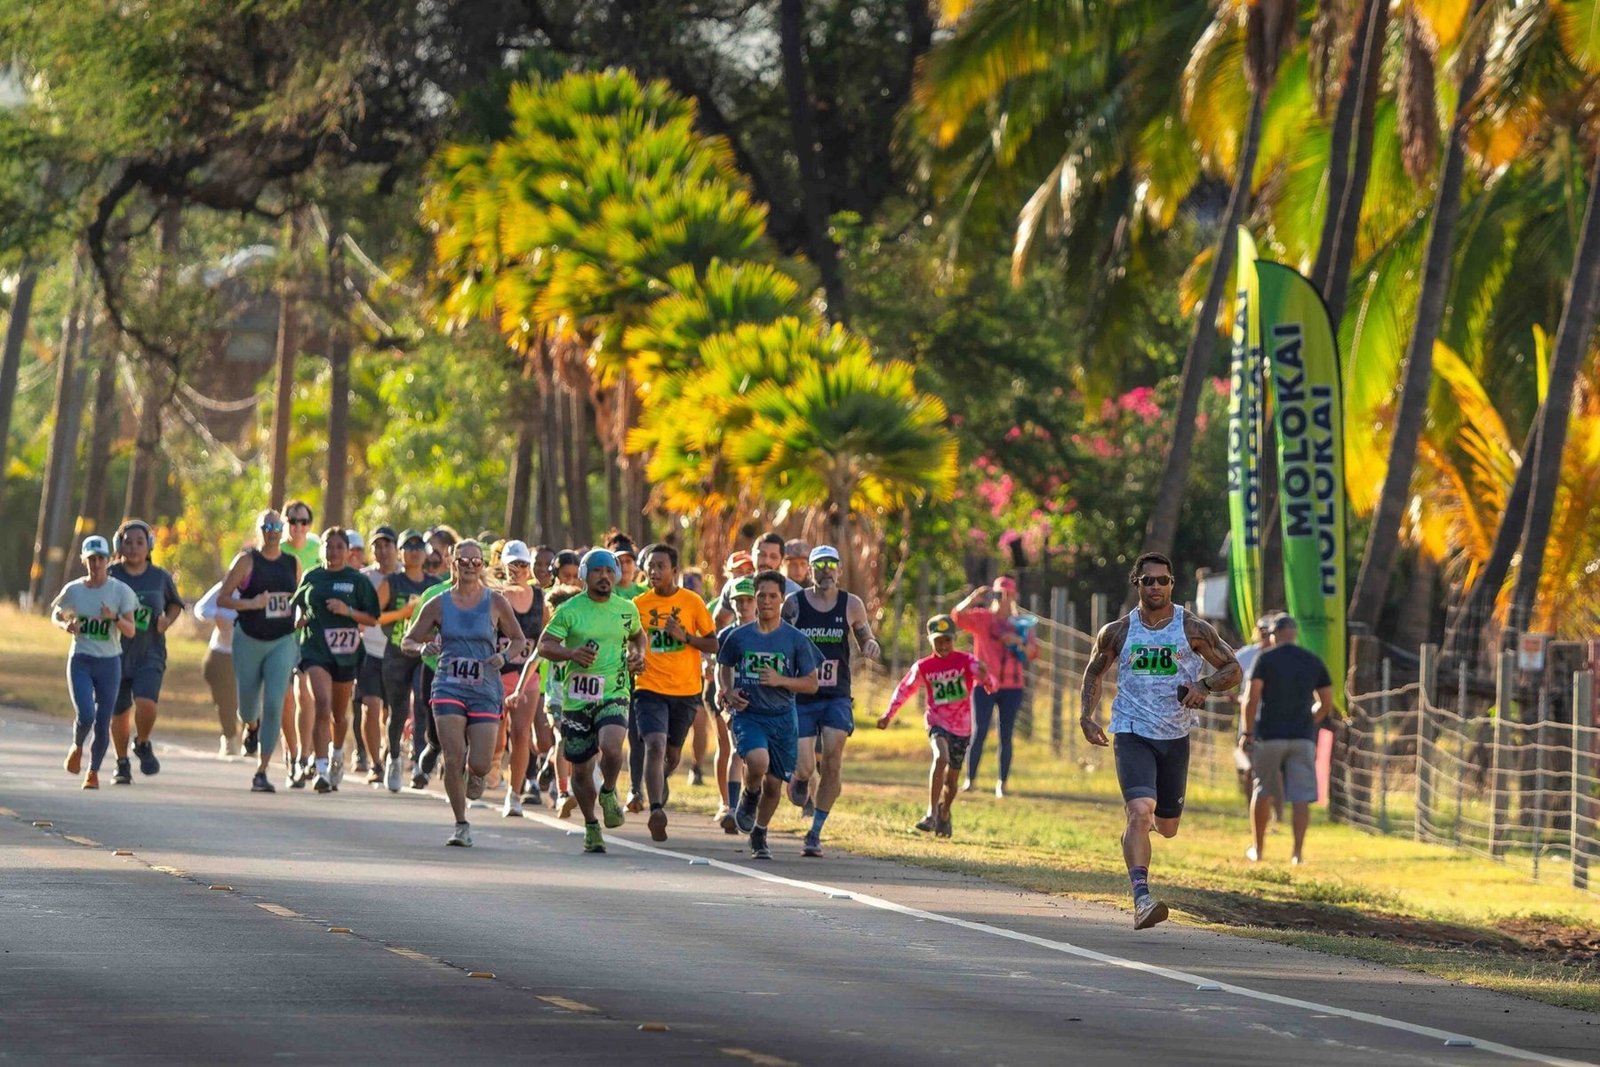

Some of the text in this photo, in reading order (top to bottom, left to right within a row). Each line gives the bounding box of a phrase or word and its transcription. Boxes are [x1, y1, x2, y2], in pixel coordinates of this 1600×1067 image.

[1274, 325, 1312, 536] MOLOKAI
[269, 596, 290, 612] 05
[80, 616, 110, 636] 300
[330, 631, 355, 648] 227
[1136, 647, 1173, 669] 378
[451, 660, 480, 679] 144
[573, 675, 600, 695] 140
[935, 678, 964, 699] 341
